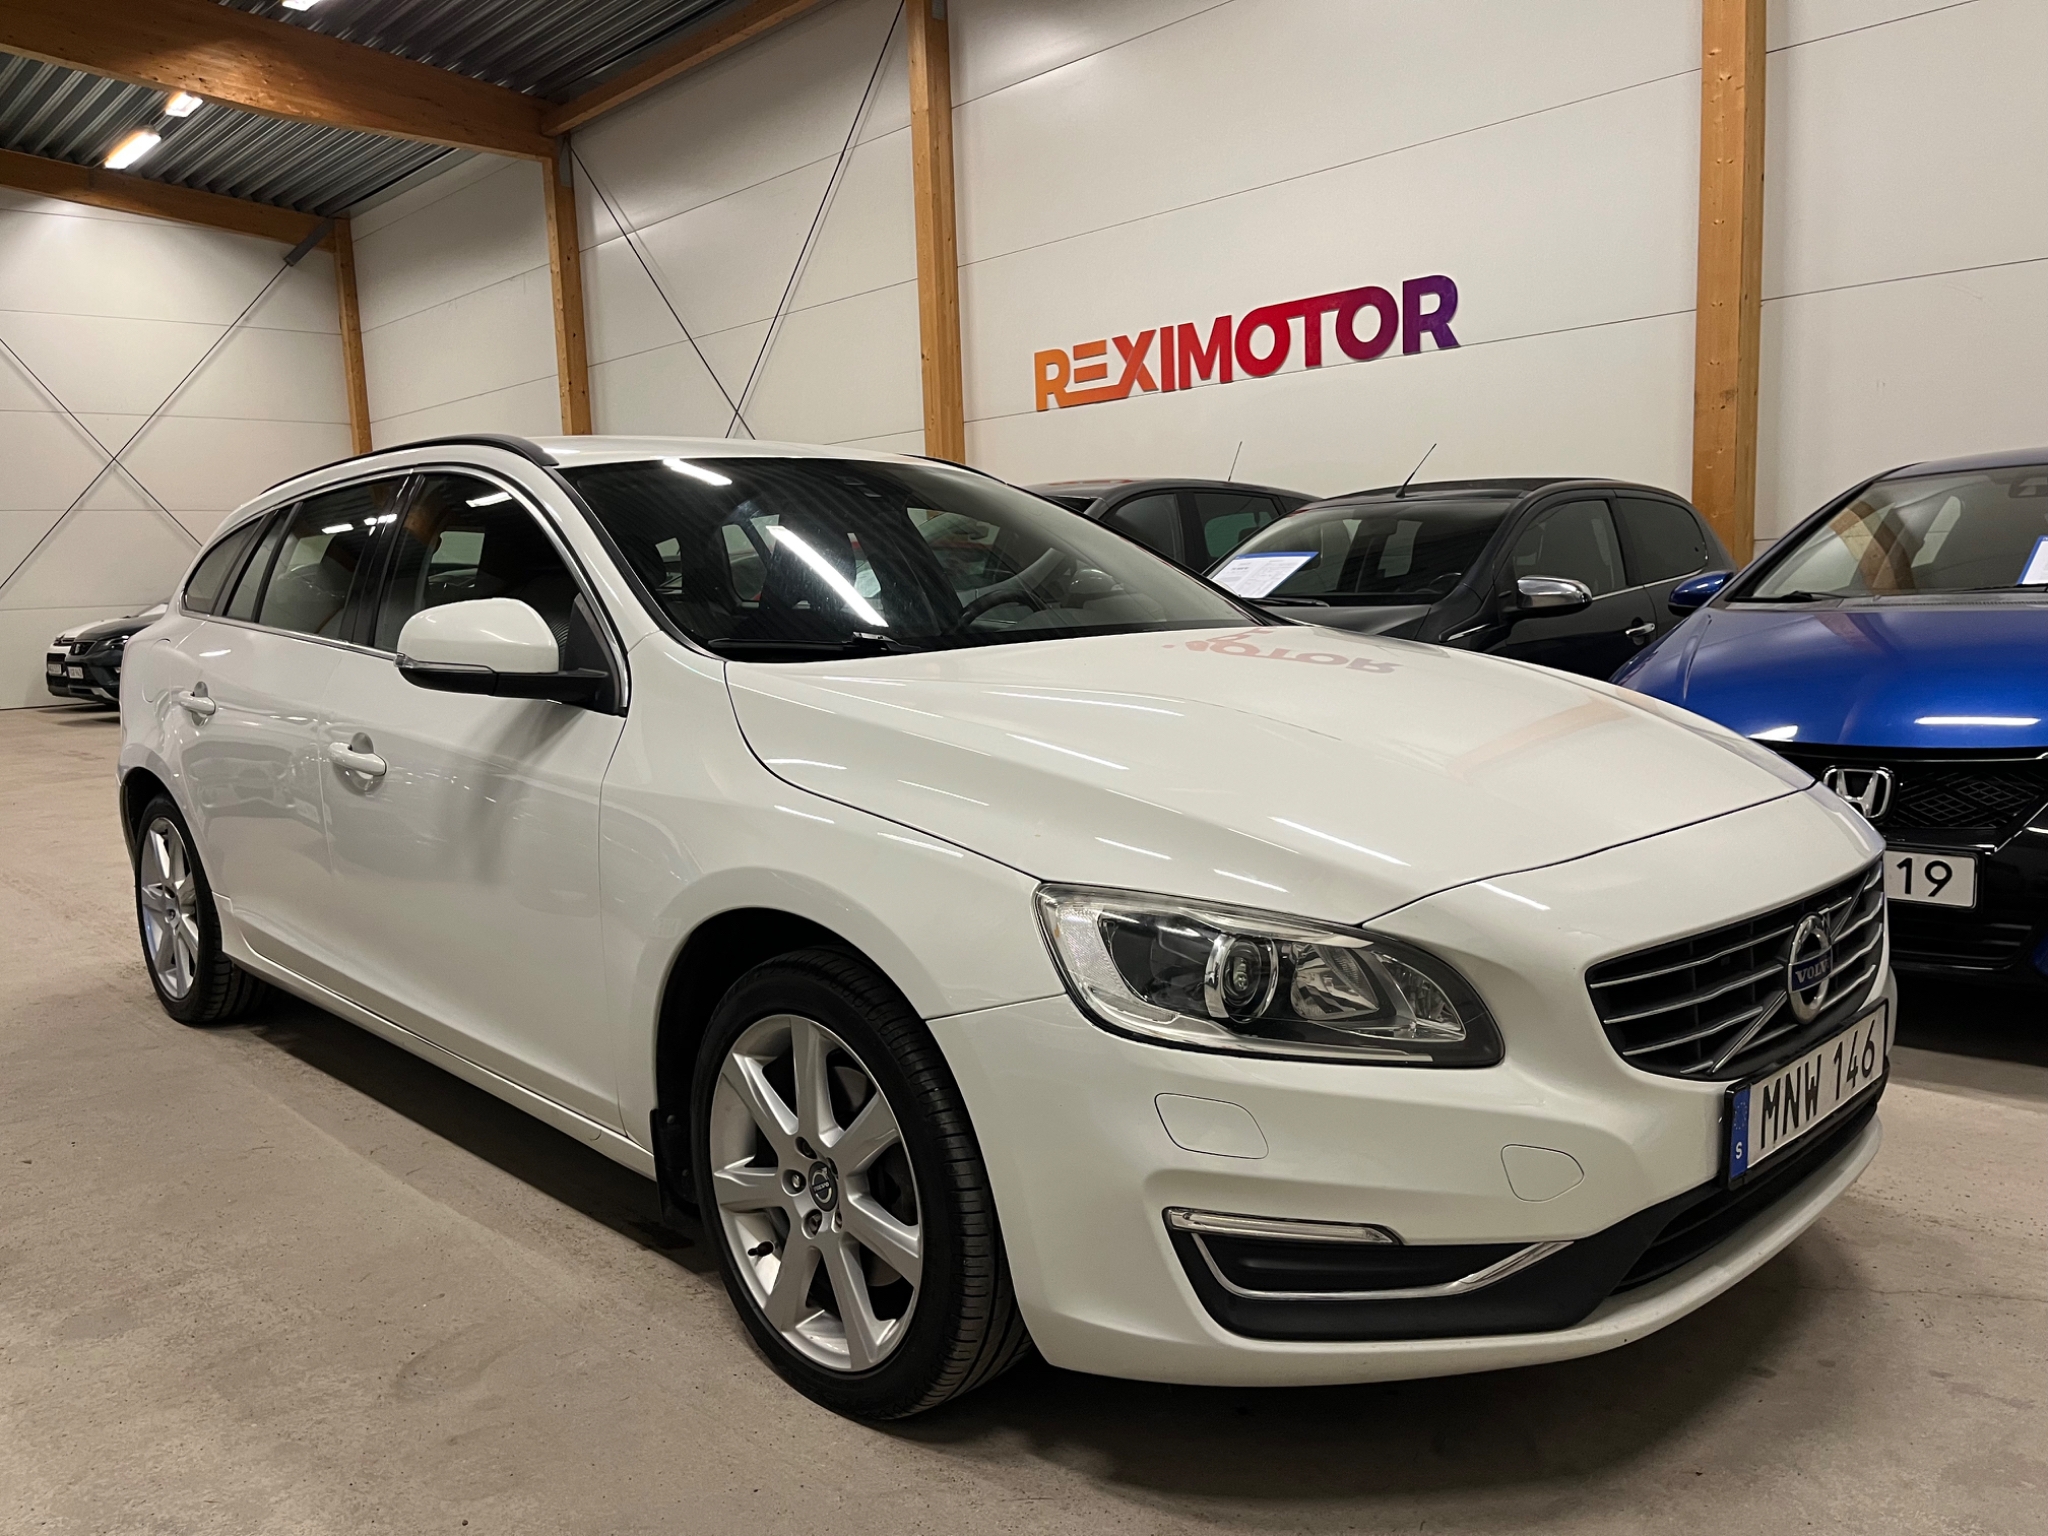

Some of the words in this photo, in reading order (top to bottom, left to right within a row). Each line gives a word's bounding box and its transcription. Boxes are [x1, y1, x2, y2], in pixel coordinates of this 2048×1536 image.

[1034, 274, 1460, 412] REXIMOTOR
[1896, 857, 1953, 897] 19
[1760, 1053, 1822, 1150] MNW
[1833, 1019, 1876, 1101] 146
[1735, 1141, 1743, 1160] S
